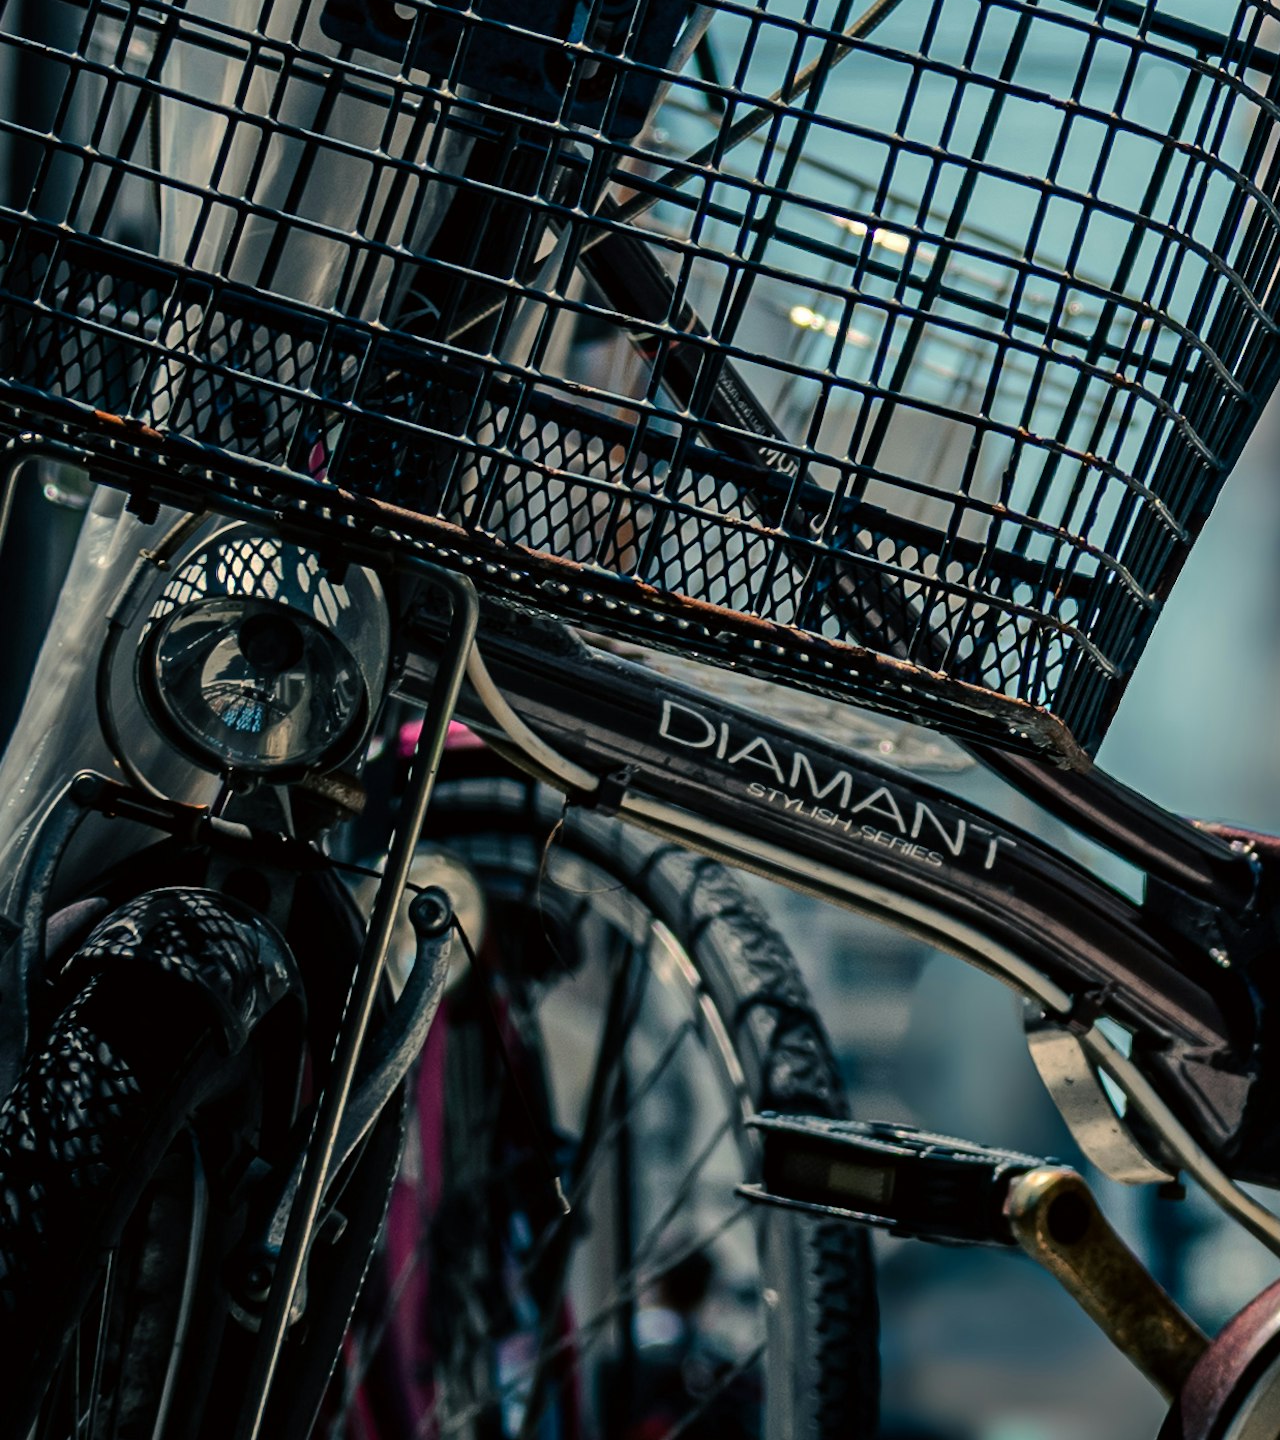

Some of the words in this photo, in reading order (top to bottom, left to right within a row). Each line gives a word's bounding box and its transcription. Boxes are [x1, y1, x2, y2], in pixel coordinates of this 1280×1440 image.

[658, 699, 1017, 870] DIAMANT
[746, 781, 854, 835] STYLISH
[860, 823, 944, 868] SERIES
